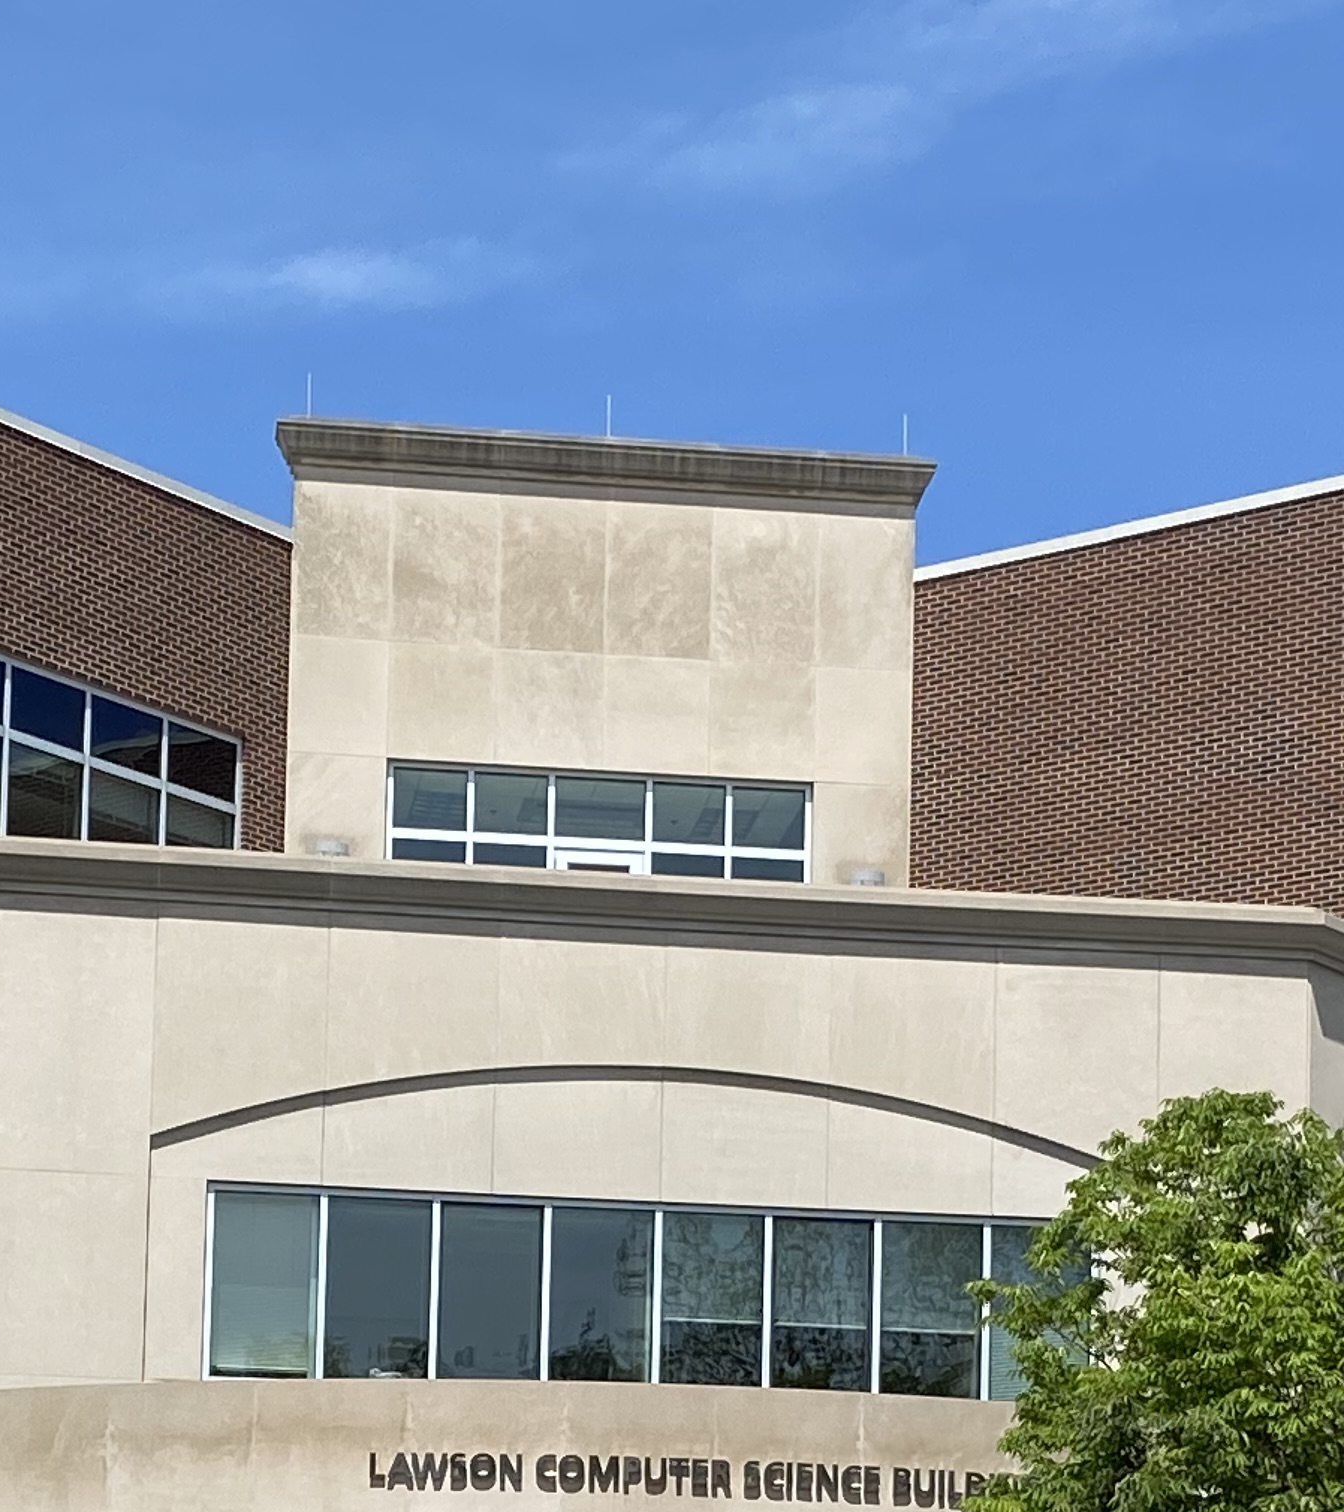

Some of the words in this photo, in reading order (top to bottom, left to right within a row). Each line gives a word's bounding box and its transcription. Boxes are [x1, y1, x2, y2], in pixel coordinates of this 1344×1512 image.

[369, 1452, 523, 1492] LAWSON
[535, 1454, 732, 1499] COMPUTER
[744, 1460, 881, 1506] SCIENCE
[893, 1467, 1001, 1511] BUILD
